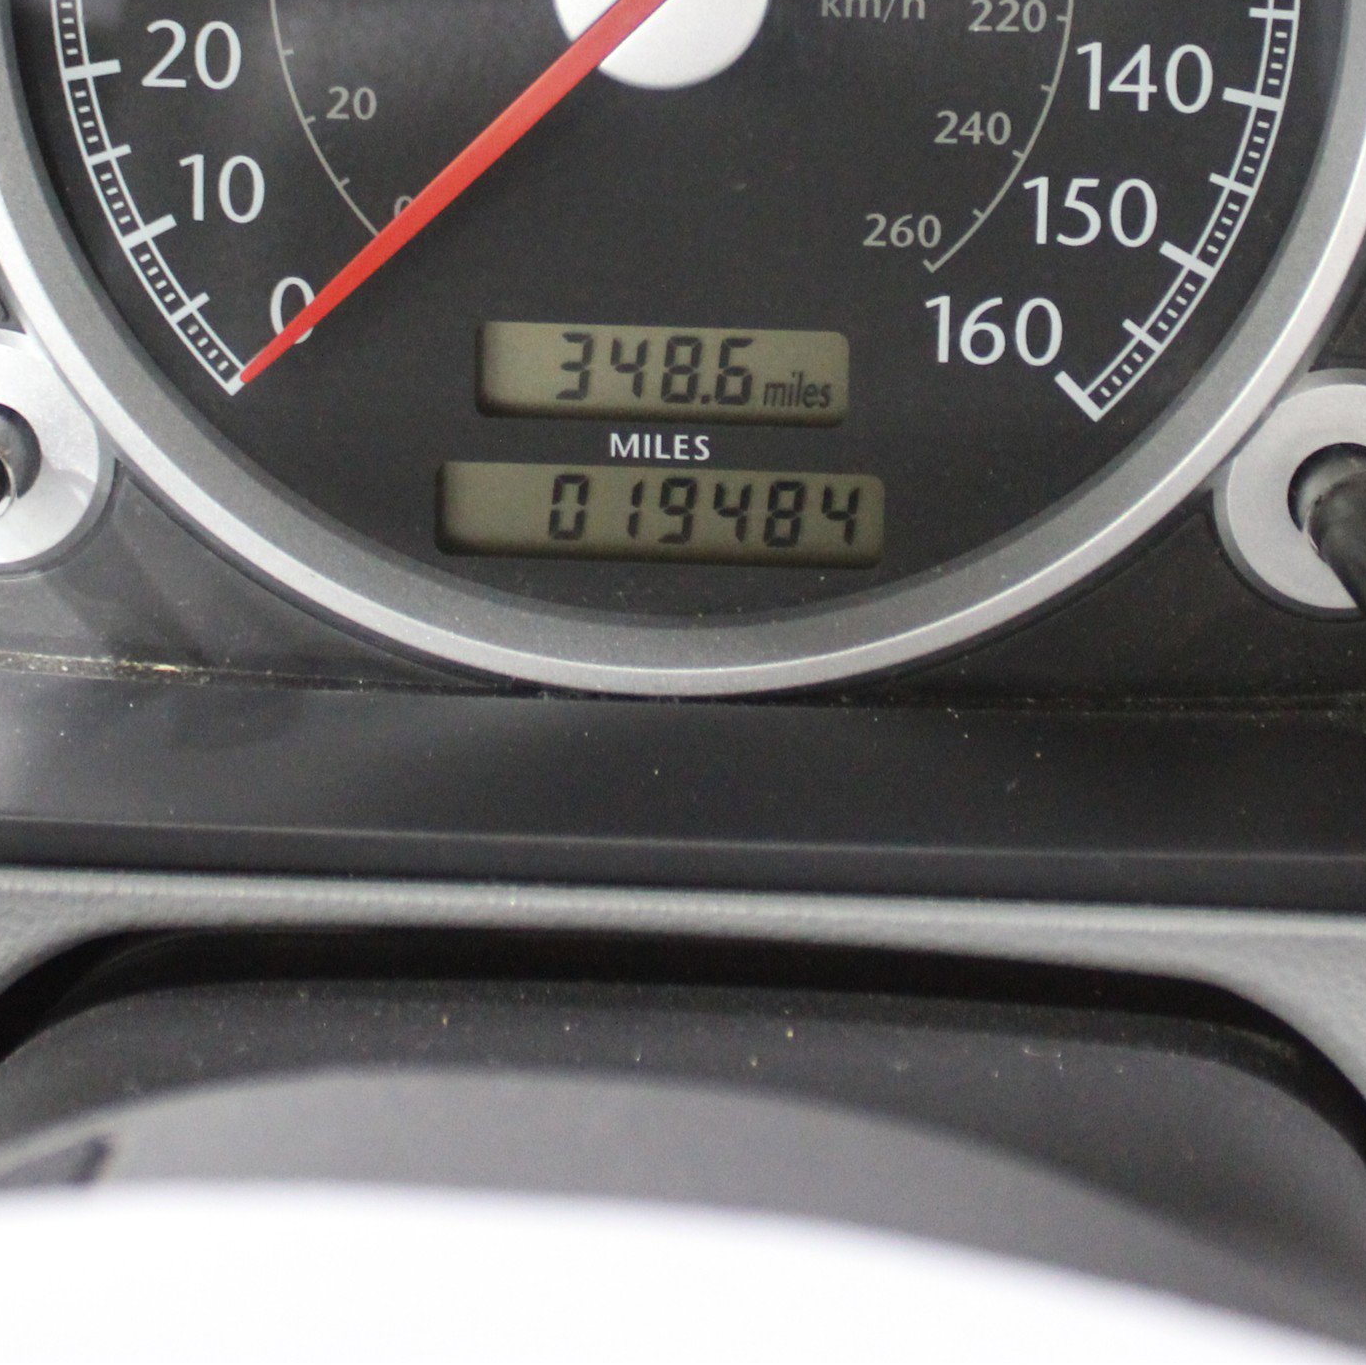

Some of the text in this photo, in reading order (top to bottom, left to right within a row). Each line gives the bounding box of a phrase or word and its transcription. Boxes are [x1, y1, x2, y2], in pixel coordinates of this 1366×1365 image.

[141, 19, 241, 90] 20
[1077, 42, 1213, 114] 140
[327, 87, 377, 120] 20
[935, 111, 1011, 145] 240
[179, 153, 265, 224] 10
[1023, 176, 1158, 248] 150
[863, 214, 941, 248] 260
[270, 276, 316, 344] 0
[925, 295, 1062, 367] 160
[556, 332, 830, 408] 348.6 miles
[610, 432, 710, 461] MILES
[549, 474, 861, 548] 019484
